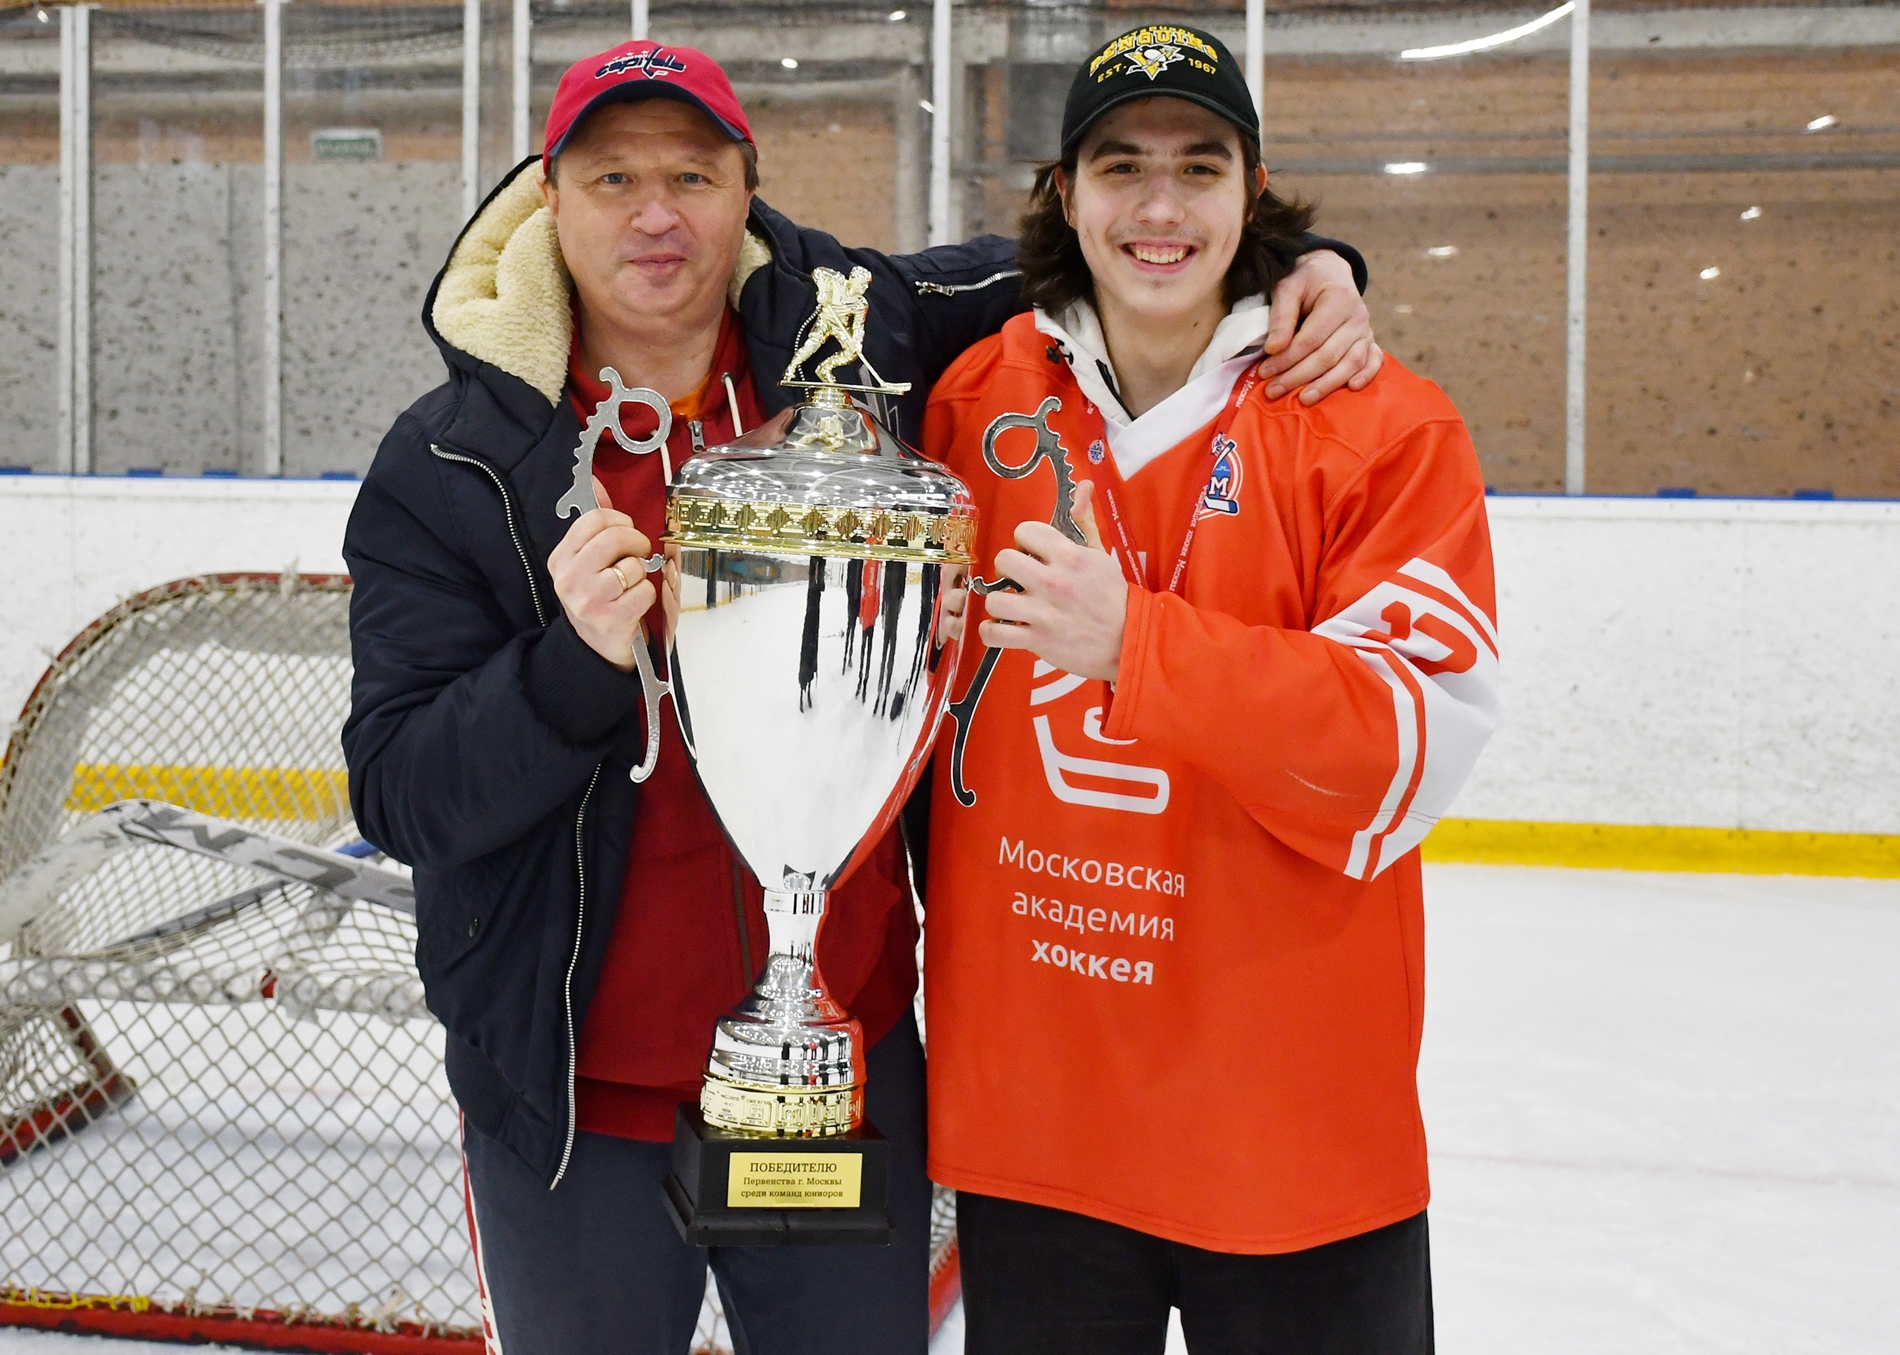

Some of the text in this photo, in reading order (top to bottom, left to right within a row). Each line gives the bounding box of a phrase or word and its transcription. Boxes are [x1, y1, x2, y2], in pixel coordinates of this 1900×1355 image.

[1089, 29, 1218, 77] PENGUINS
[1187, 57, 1217, 75] 1967
[998, 836, 1185, 898] Московская
[1011, 891, 1174, 942] академия
[1031, 939, 1154, 985] хоккея
[743, 1177, 796, 1187] Первенства
[750, 1163, 838, 1174] ПОБЕДИТЕЛЮ
[740, 1190, 843, 1198] среди команд юниоров
